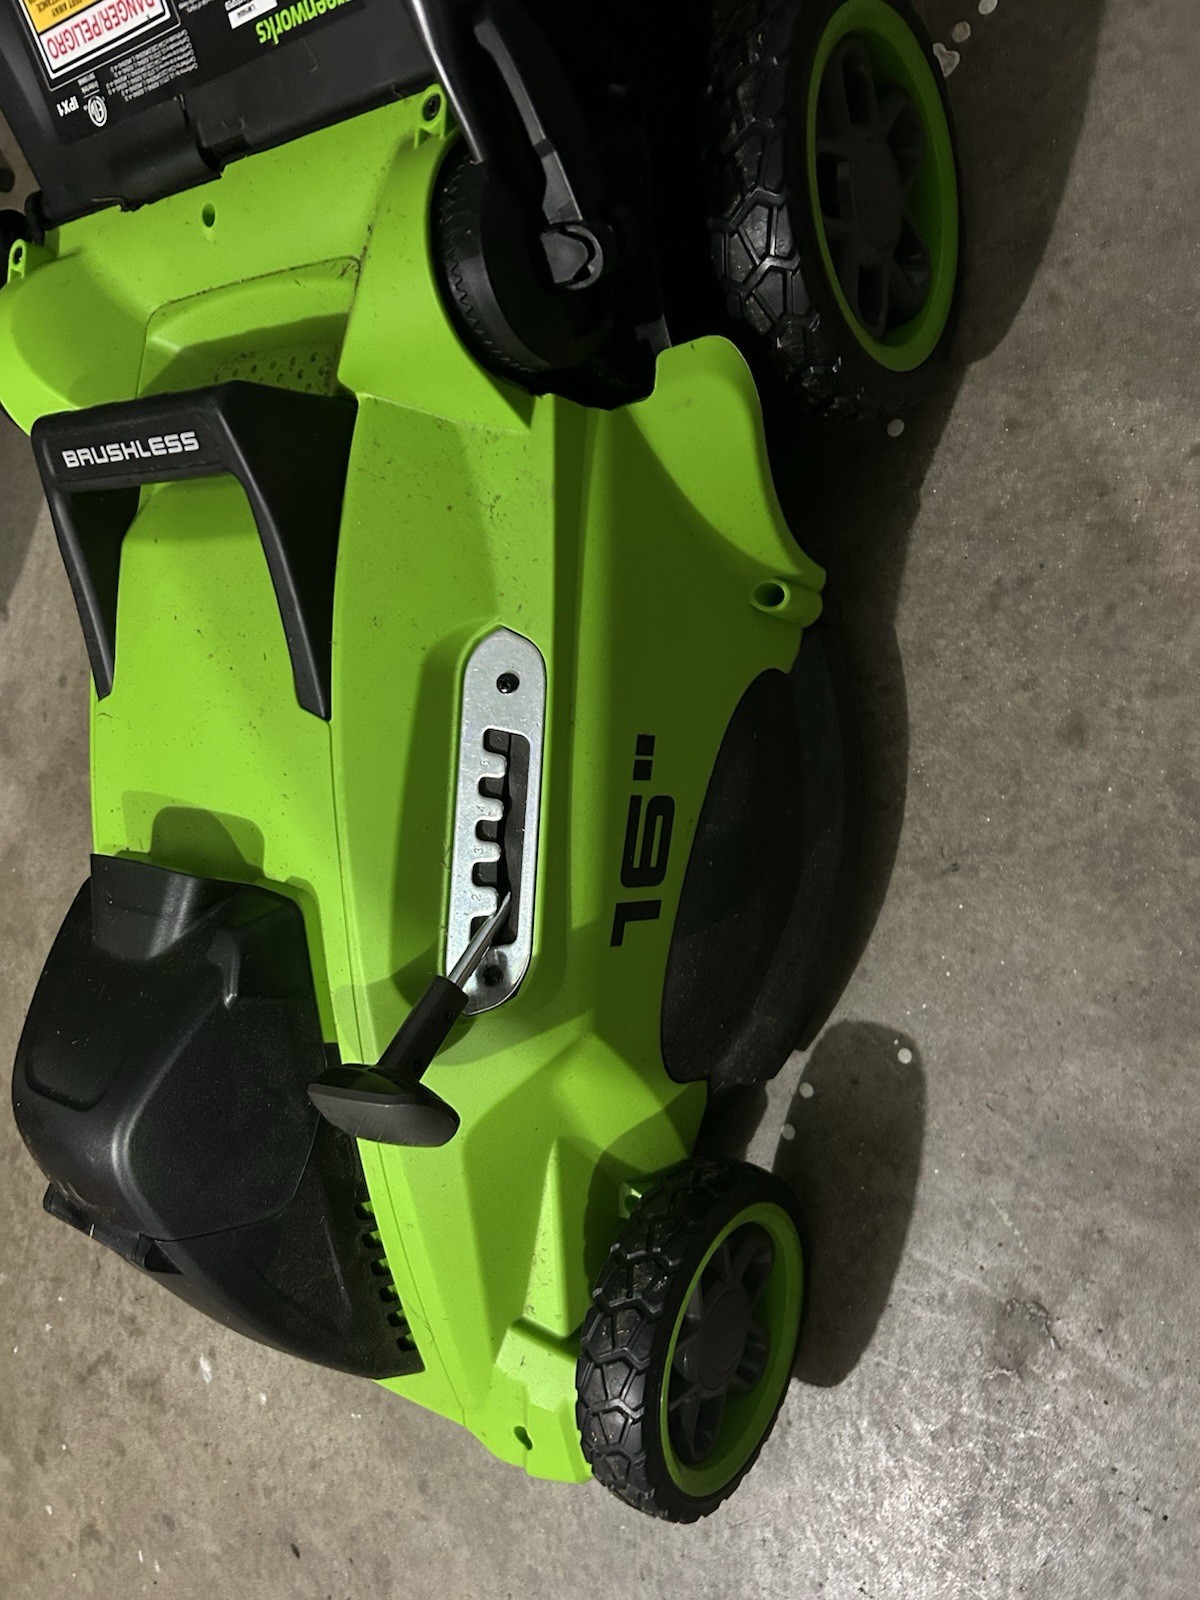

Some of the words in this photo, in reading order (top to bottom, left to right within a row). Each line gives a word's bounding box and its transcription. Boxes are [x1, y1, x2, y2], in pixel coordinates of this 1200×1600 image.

[57, 95, 79, 117] IPX1
[62, 431, 199, 468] BRUSHLESS
[471, 893, 481, 902] 2
